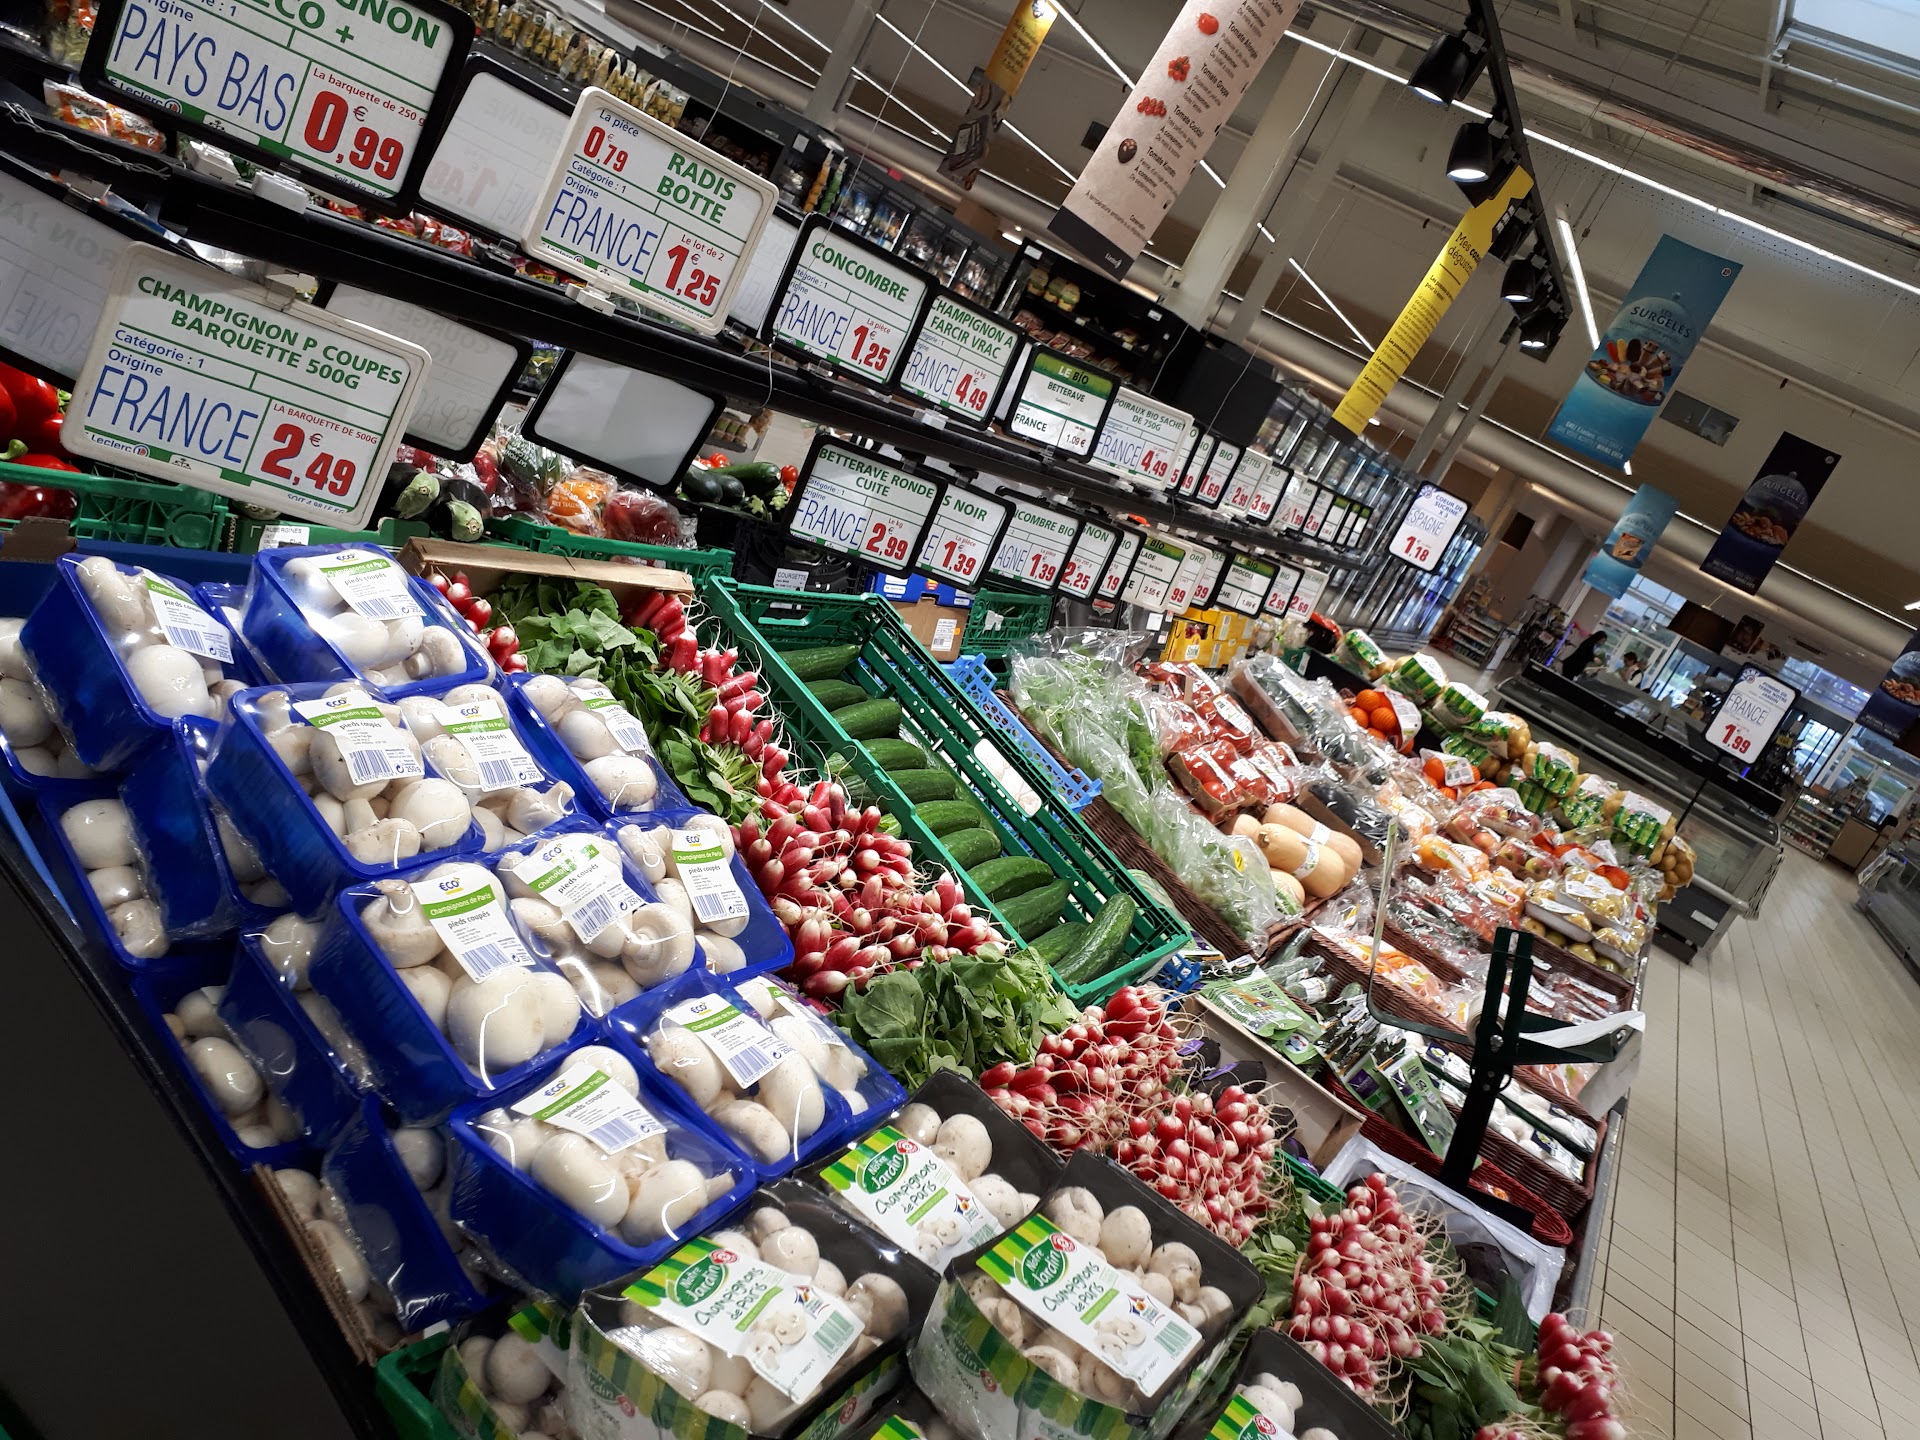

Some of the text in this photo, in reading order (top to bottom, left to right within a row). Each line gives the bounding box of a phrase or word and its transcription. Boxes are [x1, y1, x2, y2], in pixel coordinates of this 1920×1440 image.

[335, 25, 354, 43] +
[1228, 21, 1246, 43] Tomate
[113, 3, 295, 132] PAYS BAS
[1201, 63, 1218, 84] Tomate
[313, 67, 426, 127] La barquette de 250 g
[600, 110, 639, 138] La pièce
[1173, 105, 1191, 125] Tomate
[1147, 146, 1164, 166] Tomate
[565, 176, 599, 199] Origine
[571, 160, 627, 194] Catégorie 1
[667, 152, 737, 201] RADIS
[656, 175, 727, 224] BOTTE
[545, 188, 659, 276] FRANCE
[1455, 232, 1472, 252] Mes
[681, 233, 725, 261] Le lot de 2
[812, 243, 909, 303] CONCOMBRE
[789, 280, 809, 295] rigine
[137, 275, 403, 386] CHAMPIGNON P COUPES
[867, 318, 891, 335] La pièce
[930, 316, 1002, 359] FARCIR VRAC
[115, 329, 205, 369] Catégorie 1
[170, 309, 362, 391] BARQUETTE 500G
[1004, 336, 1014, 349] A
[107, 348, 164, 377] Origine
[1057, 365, 1072, 378] LE
[1047, 381, 1086, 403] BETTERAVE
[86, 365, 259, 464] FRANCE
[273, 402, 379, 446] LA BARQUETTE DE 500G
[1014, 413, 1048, 433] FRANCE
[1132, 414, 1143, 425] DE
[1146, 410, 1160, 421] BIO
[1218, 449, 1233, 461] BIO
[1242, 456, 1262, 469] GETTES
[819, 448, 935, 499] BETTERAVE RONDE
[856, 476, 890, 497] CUITE
[954, 498, 988, 522] NOIR
[1407, 507, 1445, 536] ESPAGNE
[1057, 524, 1075, 537] BIO
[1140, 551, 1157, 561] LADE
[1725, 692, 1768, 724] FRANCE
[677, 853, 706, 861] Champignons
[558, 876, 577, 893] pieds
[430, 892, 491, 916] Champignons Paris
[448, 917, 467, 929] pieds
[691, 1014, 720, 1031] Champignons
[542, 1090, 583, 1117] Champignons
[868, 1155, 888, 1174] Notre
[870, 1154, 903, 1190] Jardin
[875, 1160, 937, 1216] Champignons
[1026, 1249, 1045, 1270] Notre
[1031, 1249, 1061, 1288] Jardin
[680, 1266, 702, 1290] Notre
[685, 1263, 722, 1303] Jardin
[1042, 1261, 1101, 1313] Champignons
[695, 1266, 764, 1327] Champignons
